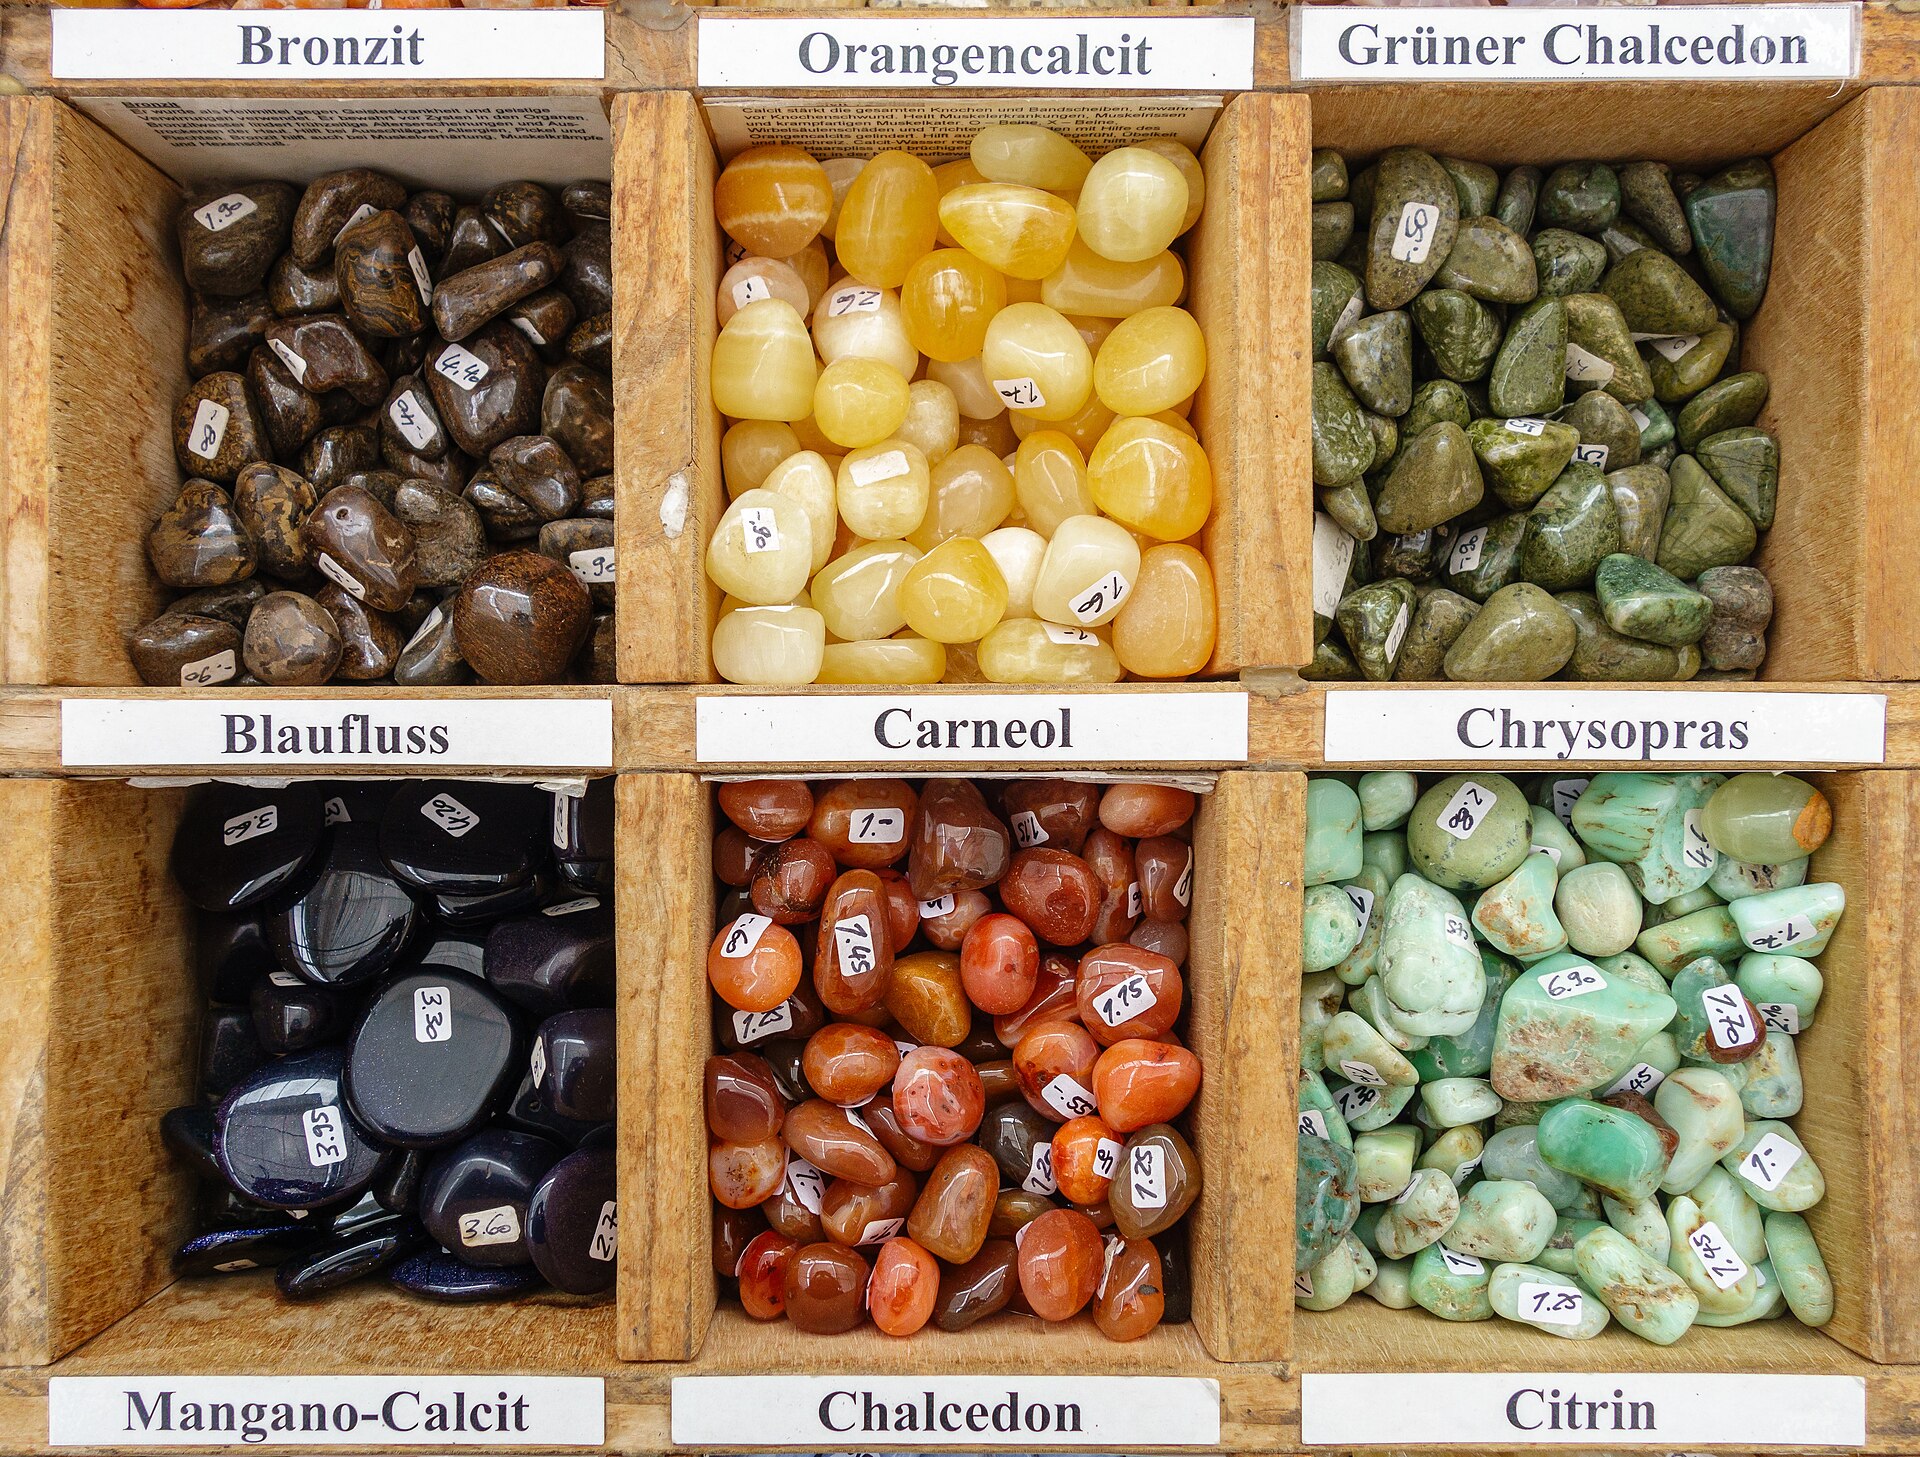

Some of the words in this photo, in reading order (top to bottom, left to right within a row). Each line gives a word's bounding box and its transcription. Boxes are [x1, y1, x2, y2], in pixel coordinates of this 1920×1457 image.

[238, 25, 424, 65] Bronzit
[799, 32, 1152, 87] Orangencalcit
[1339, 24, 1525, 66] Grüner
[1544, 24, 1807, 65] Chalcedon
[424, 114, 472, 122] Zysten
[1029, 106, 1133, 114] Bandscheiben,
[500, 134, 605, 142] Muskelkrämpfe
[205, 201, 242, 230] 1.90
[1404, 207, 1429, 262] -.50
[836, 290, 881, 315] 2.60
[1001, 381, 1038, 404] 1.70
[1077, 576, 1123, 614] 1.60
[221, 714, 449, 755] Blaufluss
[875, 707, 1073, 749] Carneol
[1457, 707, 1749, 762] Chrysopras
[224, 811, 274, 839] 3.60
[433, 799, 471, 831] 4.20
[859, 812, 893, 838] 1.-
[835, 923, 871, 974] 1.45
[1753, 922, 1800, 949] 1.70
[1548, 971, 1597, 997] 6.90
[421, 990, 443, 1040] 3.30
[1708, 993, 1746, 1045] 1.70
[310, 1109, 340, 1159] 3.95
[1134, 1146, 1158, 1201] 1.25
[1751, 1148, 1777, 1183] 1.-
[464, 1213, 512, 1240] 3.60
[1693, 1232, 1740, 1278] 1.45
[1533, 1291, 1583, 1313] 1.25
[123, 1391, 529, 1443] Mangano-Calcit
[819, 1390, 1082, 1432] Chalcedon
[1507, 1388, 1656, 1430] Citrin
